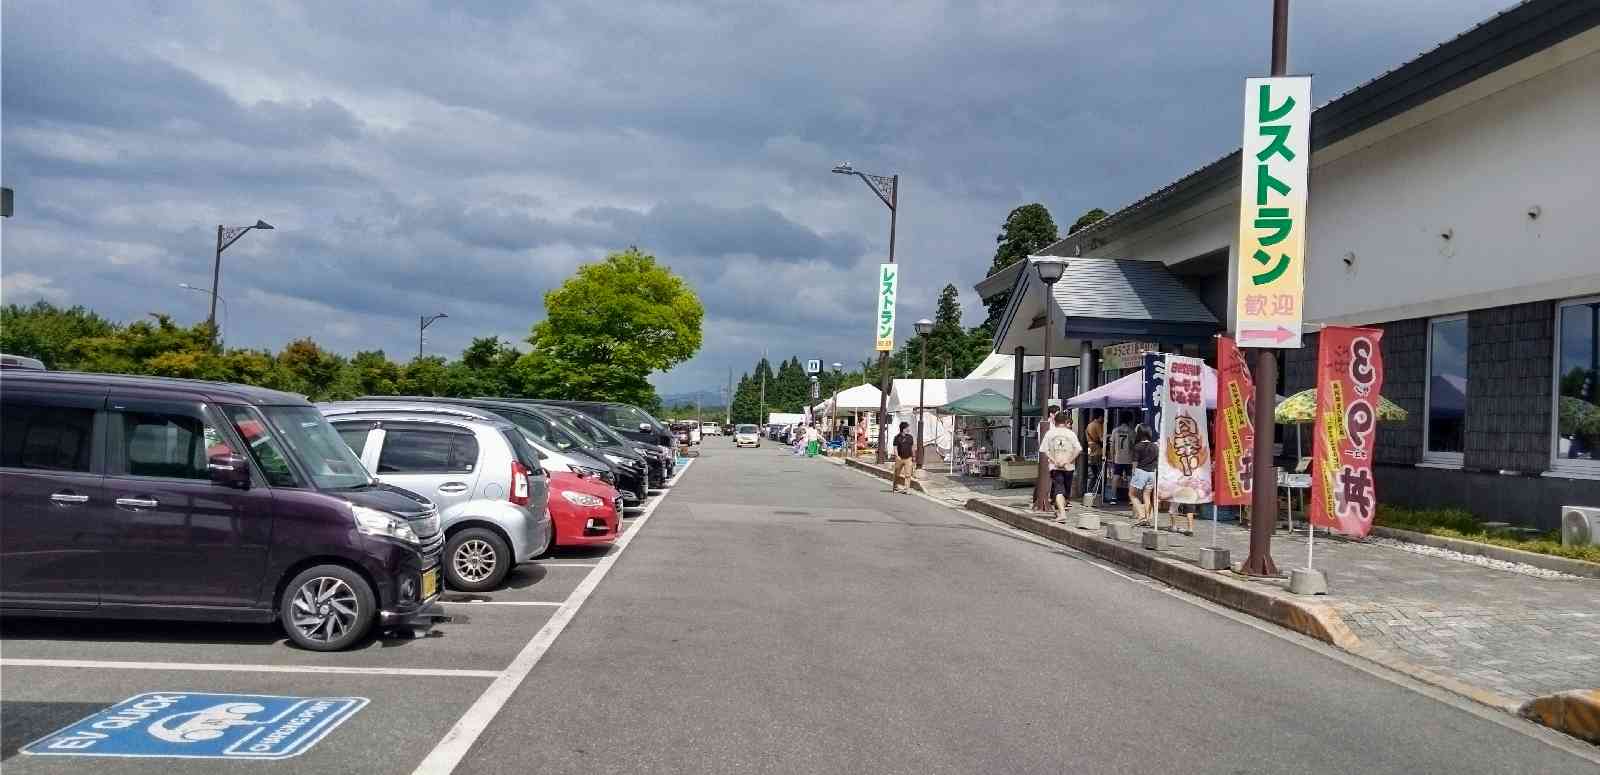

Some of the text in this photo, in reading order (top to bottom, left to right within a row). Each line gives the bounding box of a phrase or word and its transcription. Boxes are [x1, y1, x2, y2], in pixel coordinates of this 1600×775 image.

[1252, 84, 1297, 286] レストラン
[880, 267, 895, 338] レストラン
[1243, 294, 1294, 316] 歓迎
[1119, 434, 1128, 449] 7
[48, 695, 187, 749] EV QUICK
